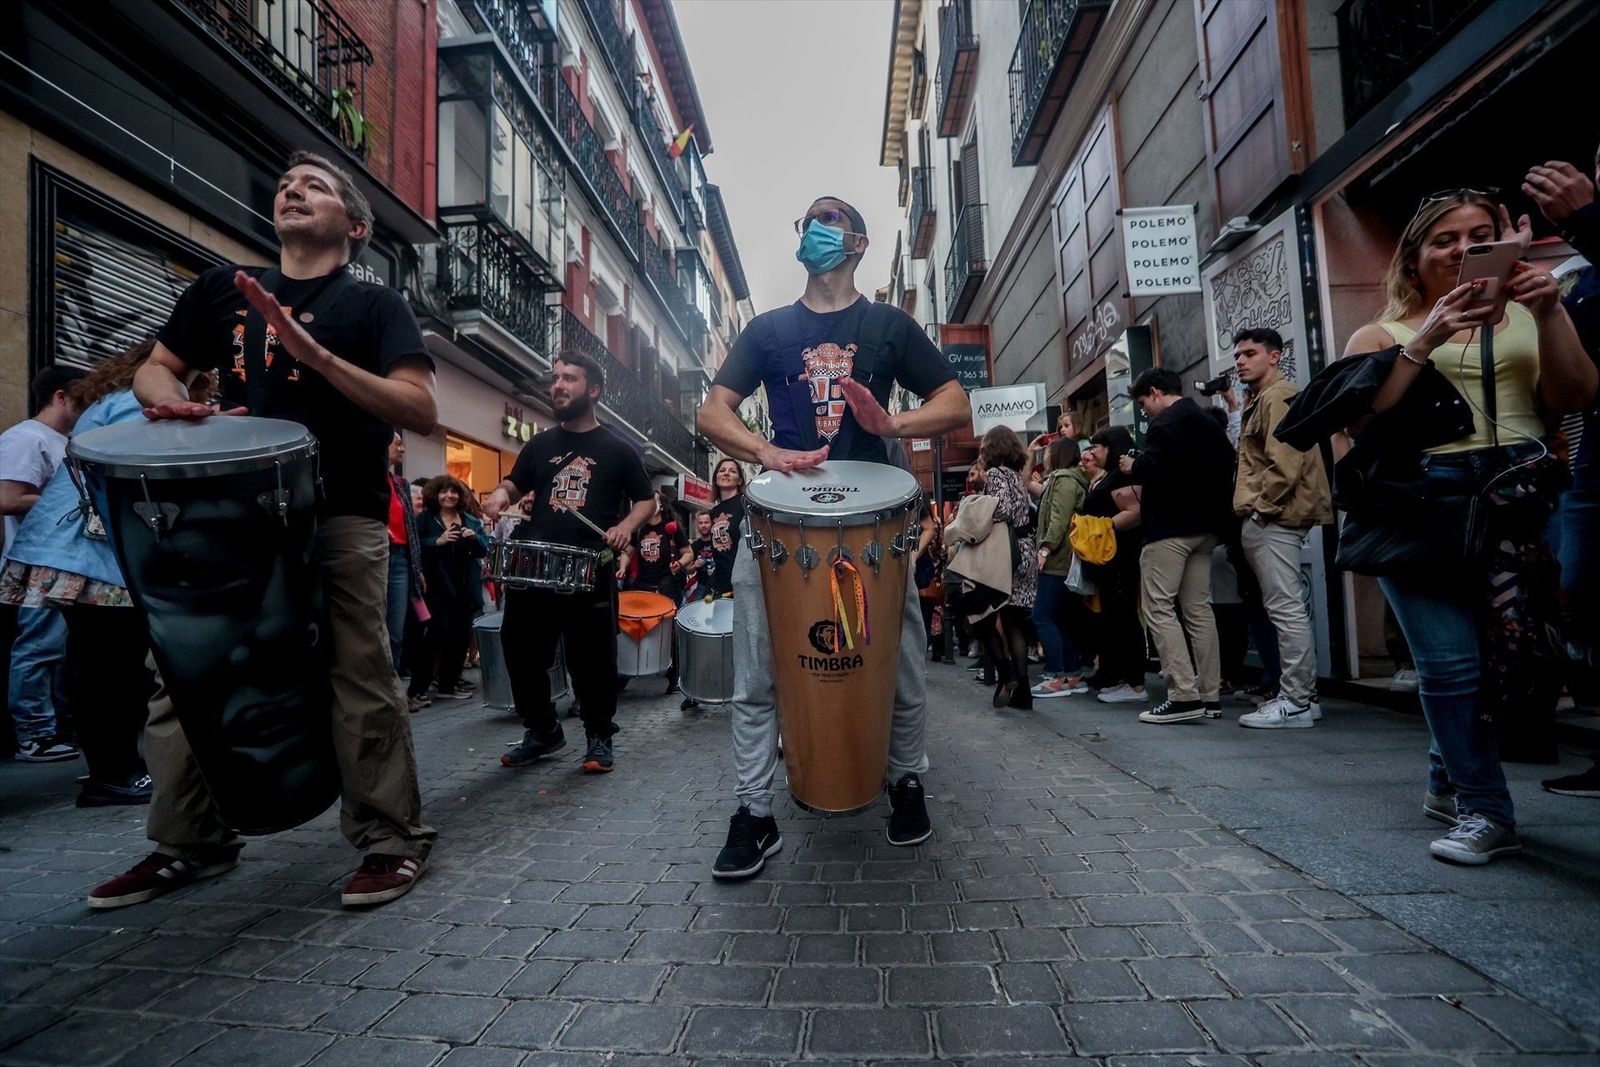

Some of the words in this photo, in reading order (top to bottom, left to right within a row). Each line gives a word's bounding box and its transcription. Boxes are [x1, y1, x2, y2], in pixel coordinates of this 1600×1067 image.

[1130, 217, 1186, 229] POLEMO
[1132, 236, 1188, 248] POLEMO
[1134, 257, 1190, 268] POLEMO
[1136, 276, 1191, 287] POLEMO
[948, 353, 962, 363] GV
[977, 399, 1034, 414] ARAMAYO
[797, 653, 864, 671] TIMBRA
